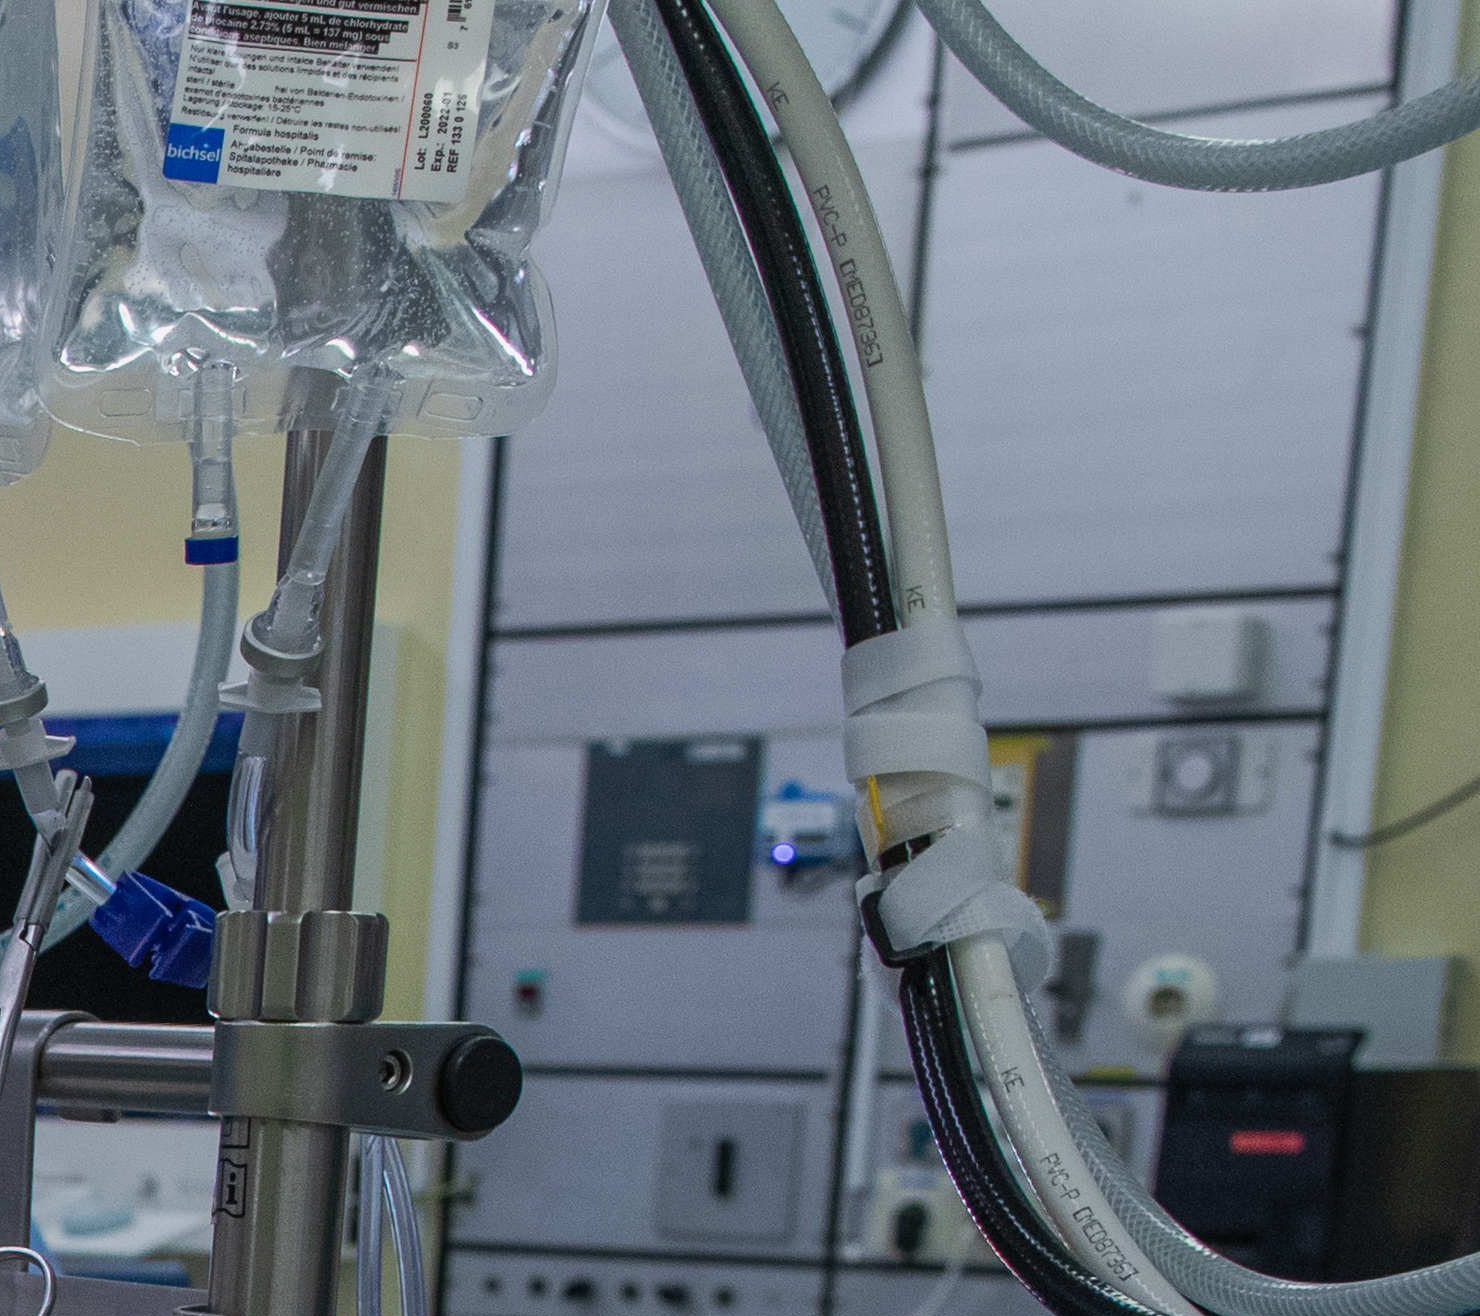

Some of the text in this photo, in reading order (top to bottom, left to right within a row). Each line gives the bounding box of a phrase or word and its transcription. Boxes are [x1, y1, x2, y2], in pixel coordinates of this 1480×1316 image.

[339, 1, 354, 11] gut
[360, 3, 417, 13] vermischen
[263, 8, 299, 23] ajouter
[301, 13, 307, 21] 5
[328, 16, 341, 26] de
[343, 16, 407, 32] chlorhydrate
[303, 37, 326, 48] Bien
[341, 29, 363, 43] mg)
[365, 32, 389, 42] sous
[269, 53, 284, 62] und
[258, 62, 294, 74] solutions
[766, 82, 789, 111] KE
[232, 124, 318, 143] Formula hospitalis
[449, 125, 463, 145] 133
[167, 143, 220, 162] bichsel
[229, 151, 298, 168] Spitalapotheke
[300, 146, 323, 157] Point
[413, 147, 427, 170] Lot:
[444, 148, 460, 173] REF
[812, 184, 848, 247] PVC-P
[905, 585, 925, 610] KE
[1000, 1066, 1024, 1094] KE
[1040, 1152, 1081, 1213] PVC-P
